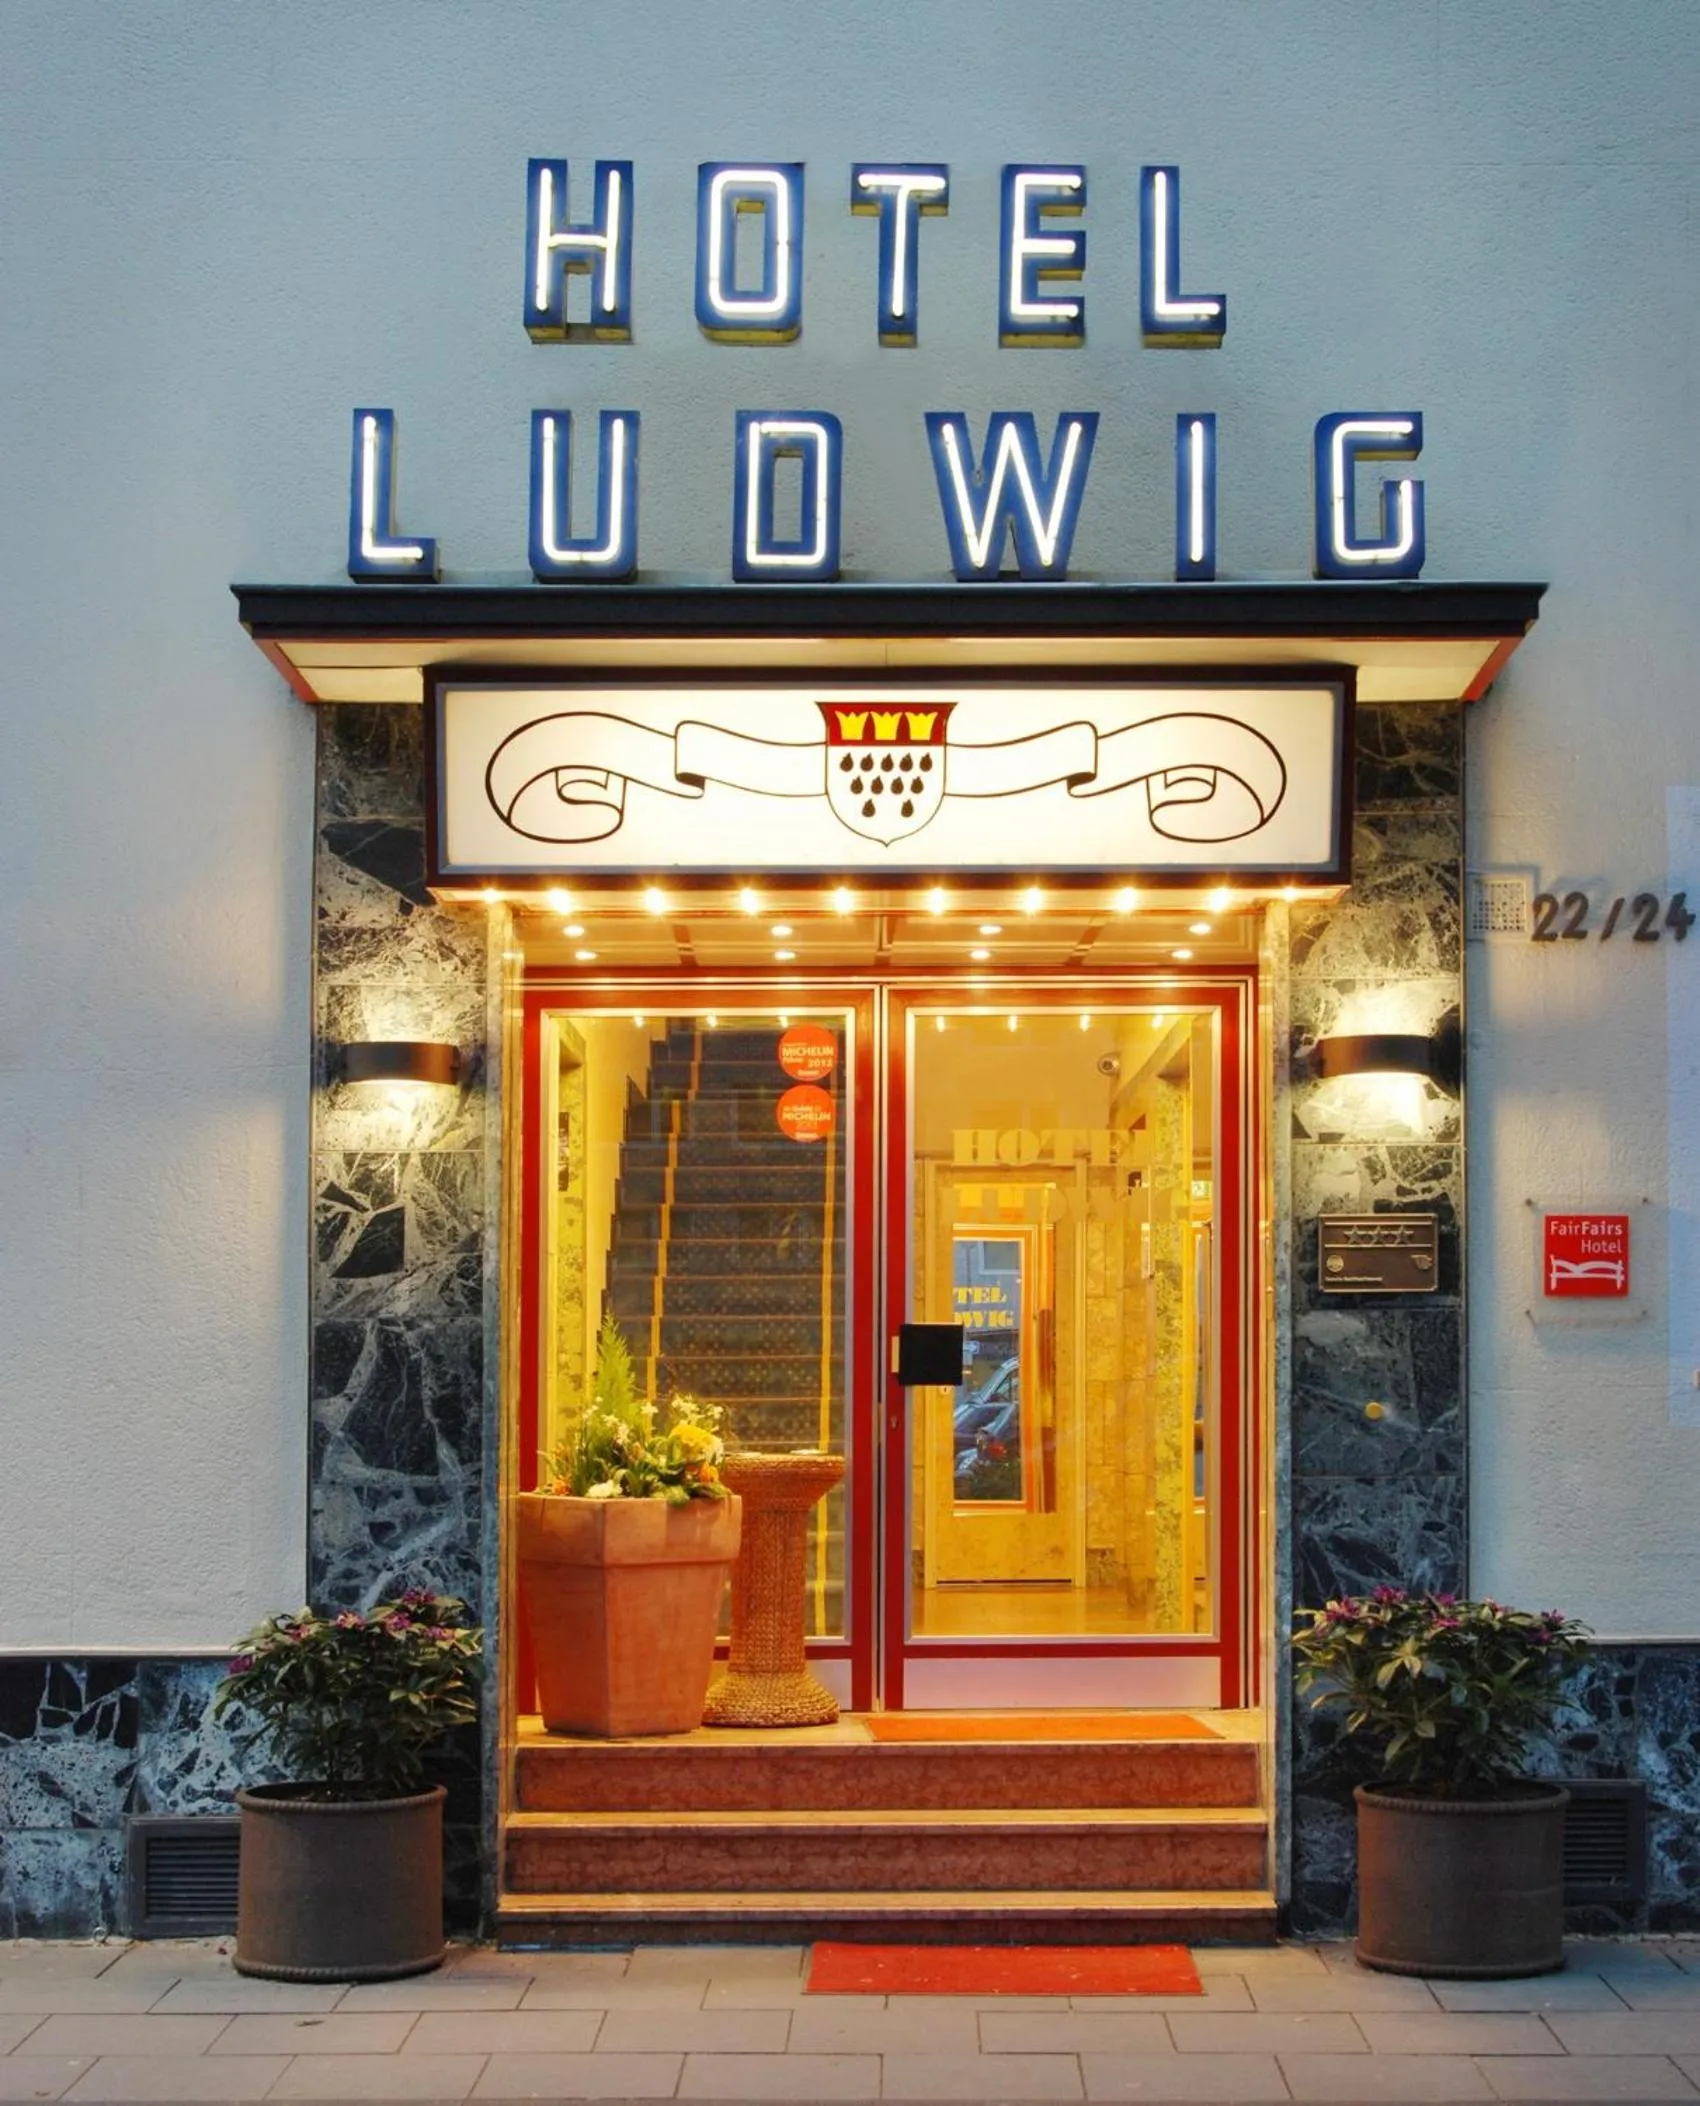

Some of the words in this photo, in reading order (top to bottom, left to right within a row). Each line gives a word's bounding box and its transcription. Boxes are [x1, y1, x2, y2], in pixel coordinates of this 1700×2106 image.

[524, 158, 1226, 346] HOTEL
[348, 408, 1425, 582] LUDWIG
[1531, 890, 1697, 942] 22/24
[781, 1045, 834, 1058] MICHELIN
[1550, 1219, 1623, 1236] FairFairs
[1580, 1238, 1623, 1254] Hotel
